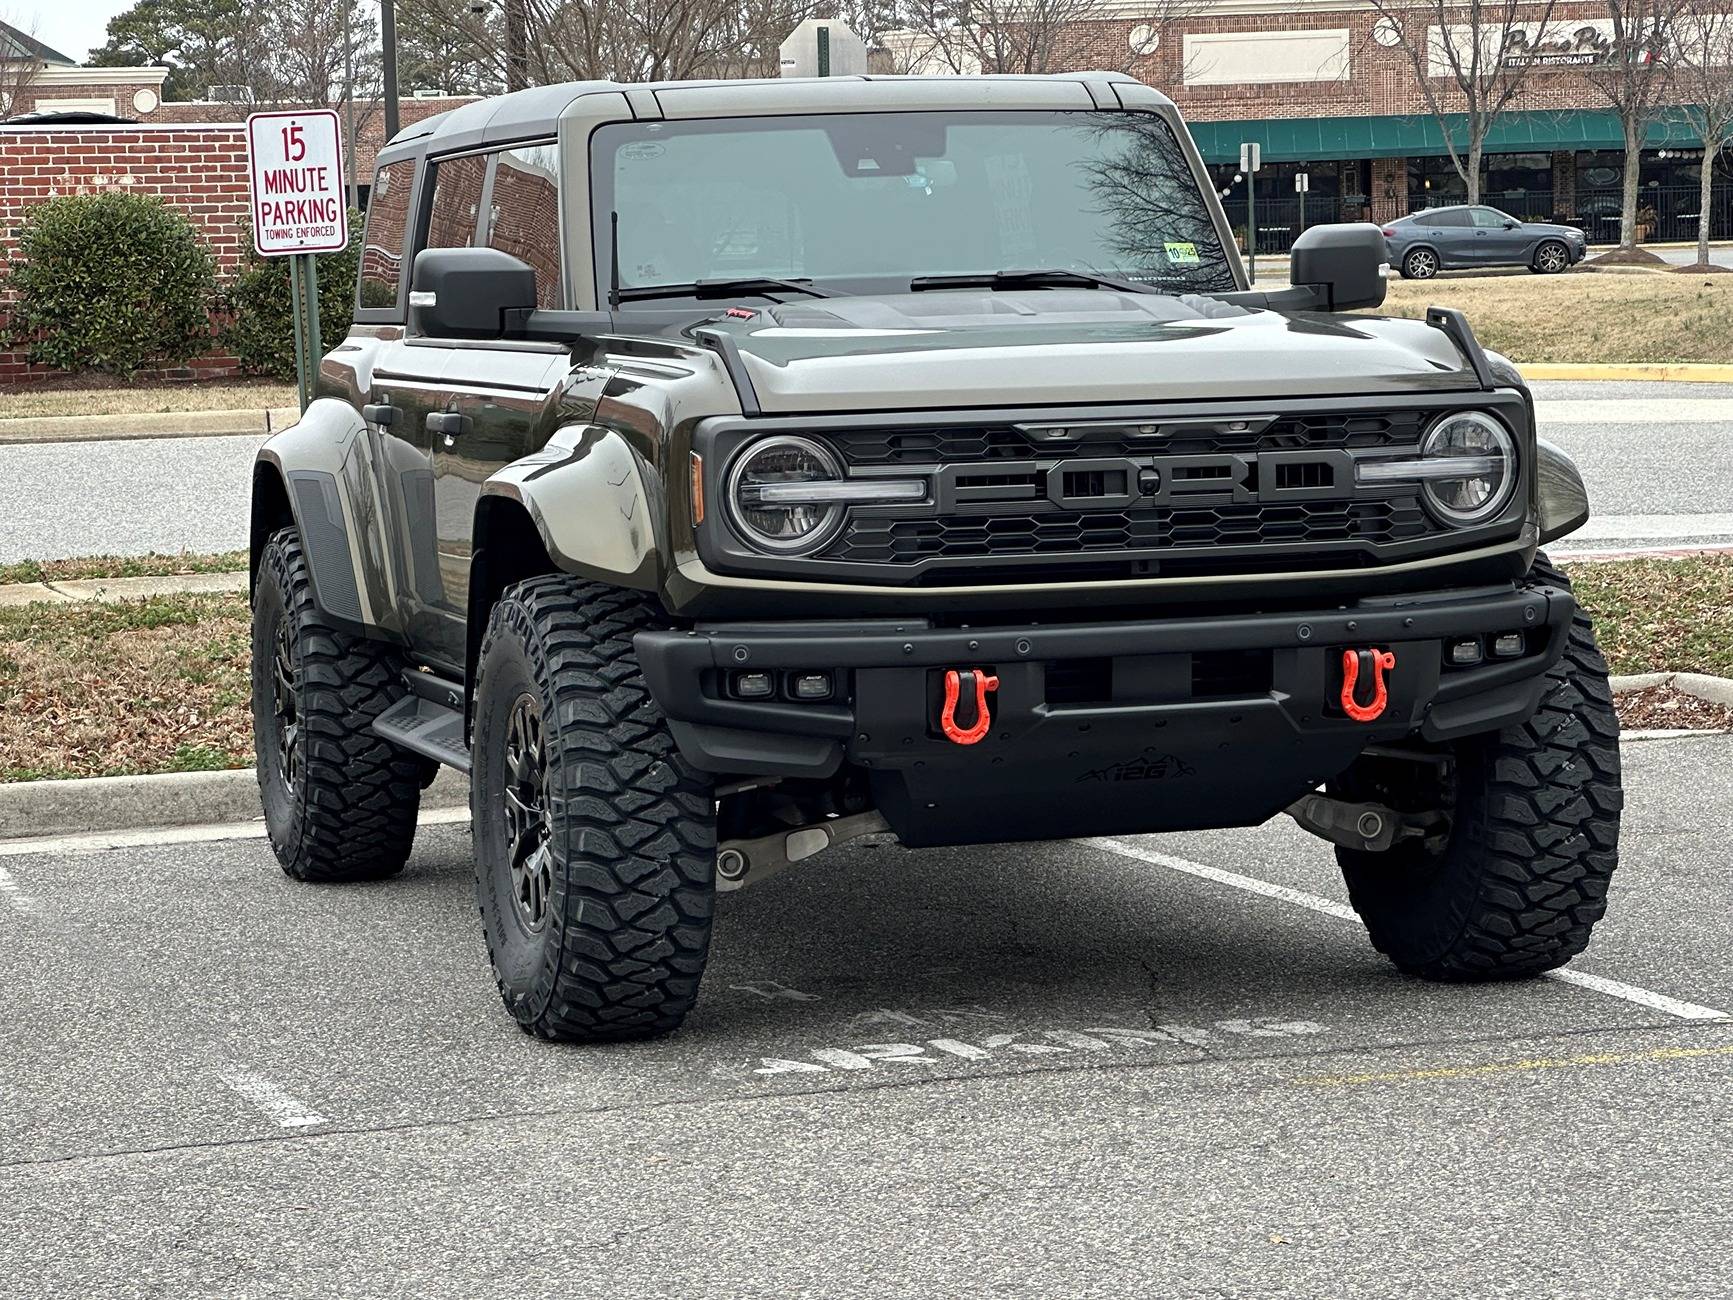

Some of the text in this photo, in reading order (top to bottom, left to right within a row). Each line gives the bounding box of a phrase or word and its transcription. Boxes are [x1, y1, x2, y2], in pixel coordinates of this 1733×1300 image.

[281, 127, 306, 162] 15
[264, 167, 328, 194] MINUTE
[261, 198, 337, 226] PARKING
[265, 226, 335, 240] TOWING ENFORCED
[1169, 248, 1180, 259] 10
[936, 449, 1353, 515] FORD
